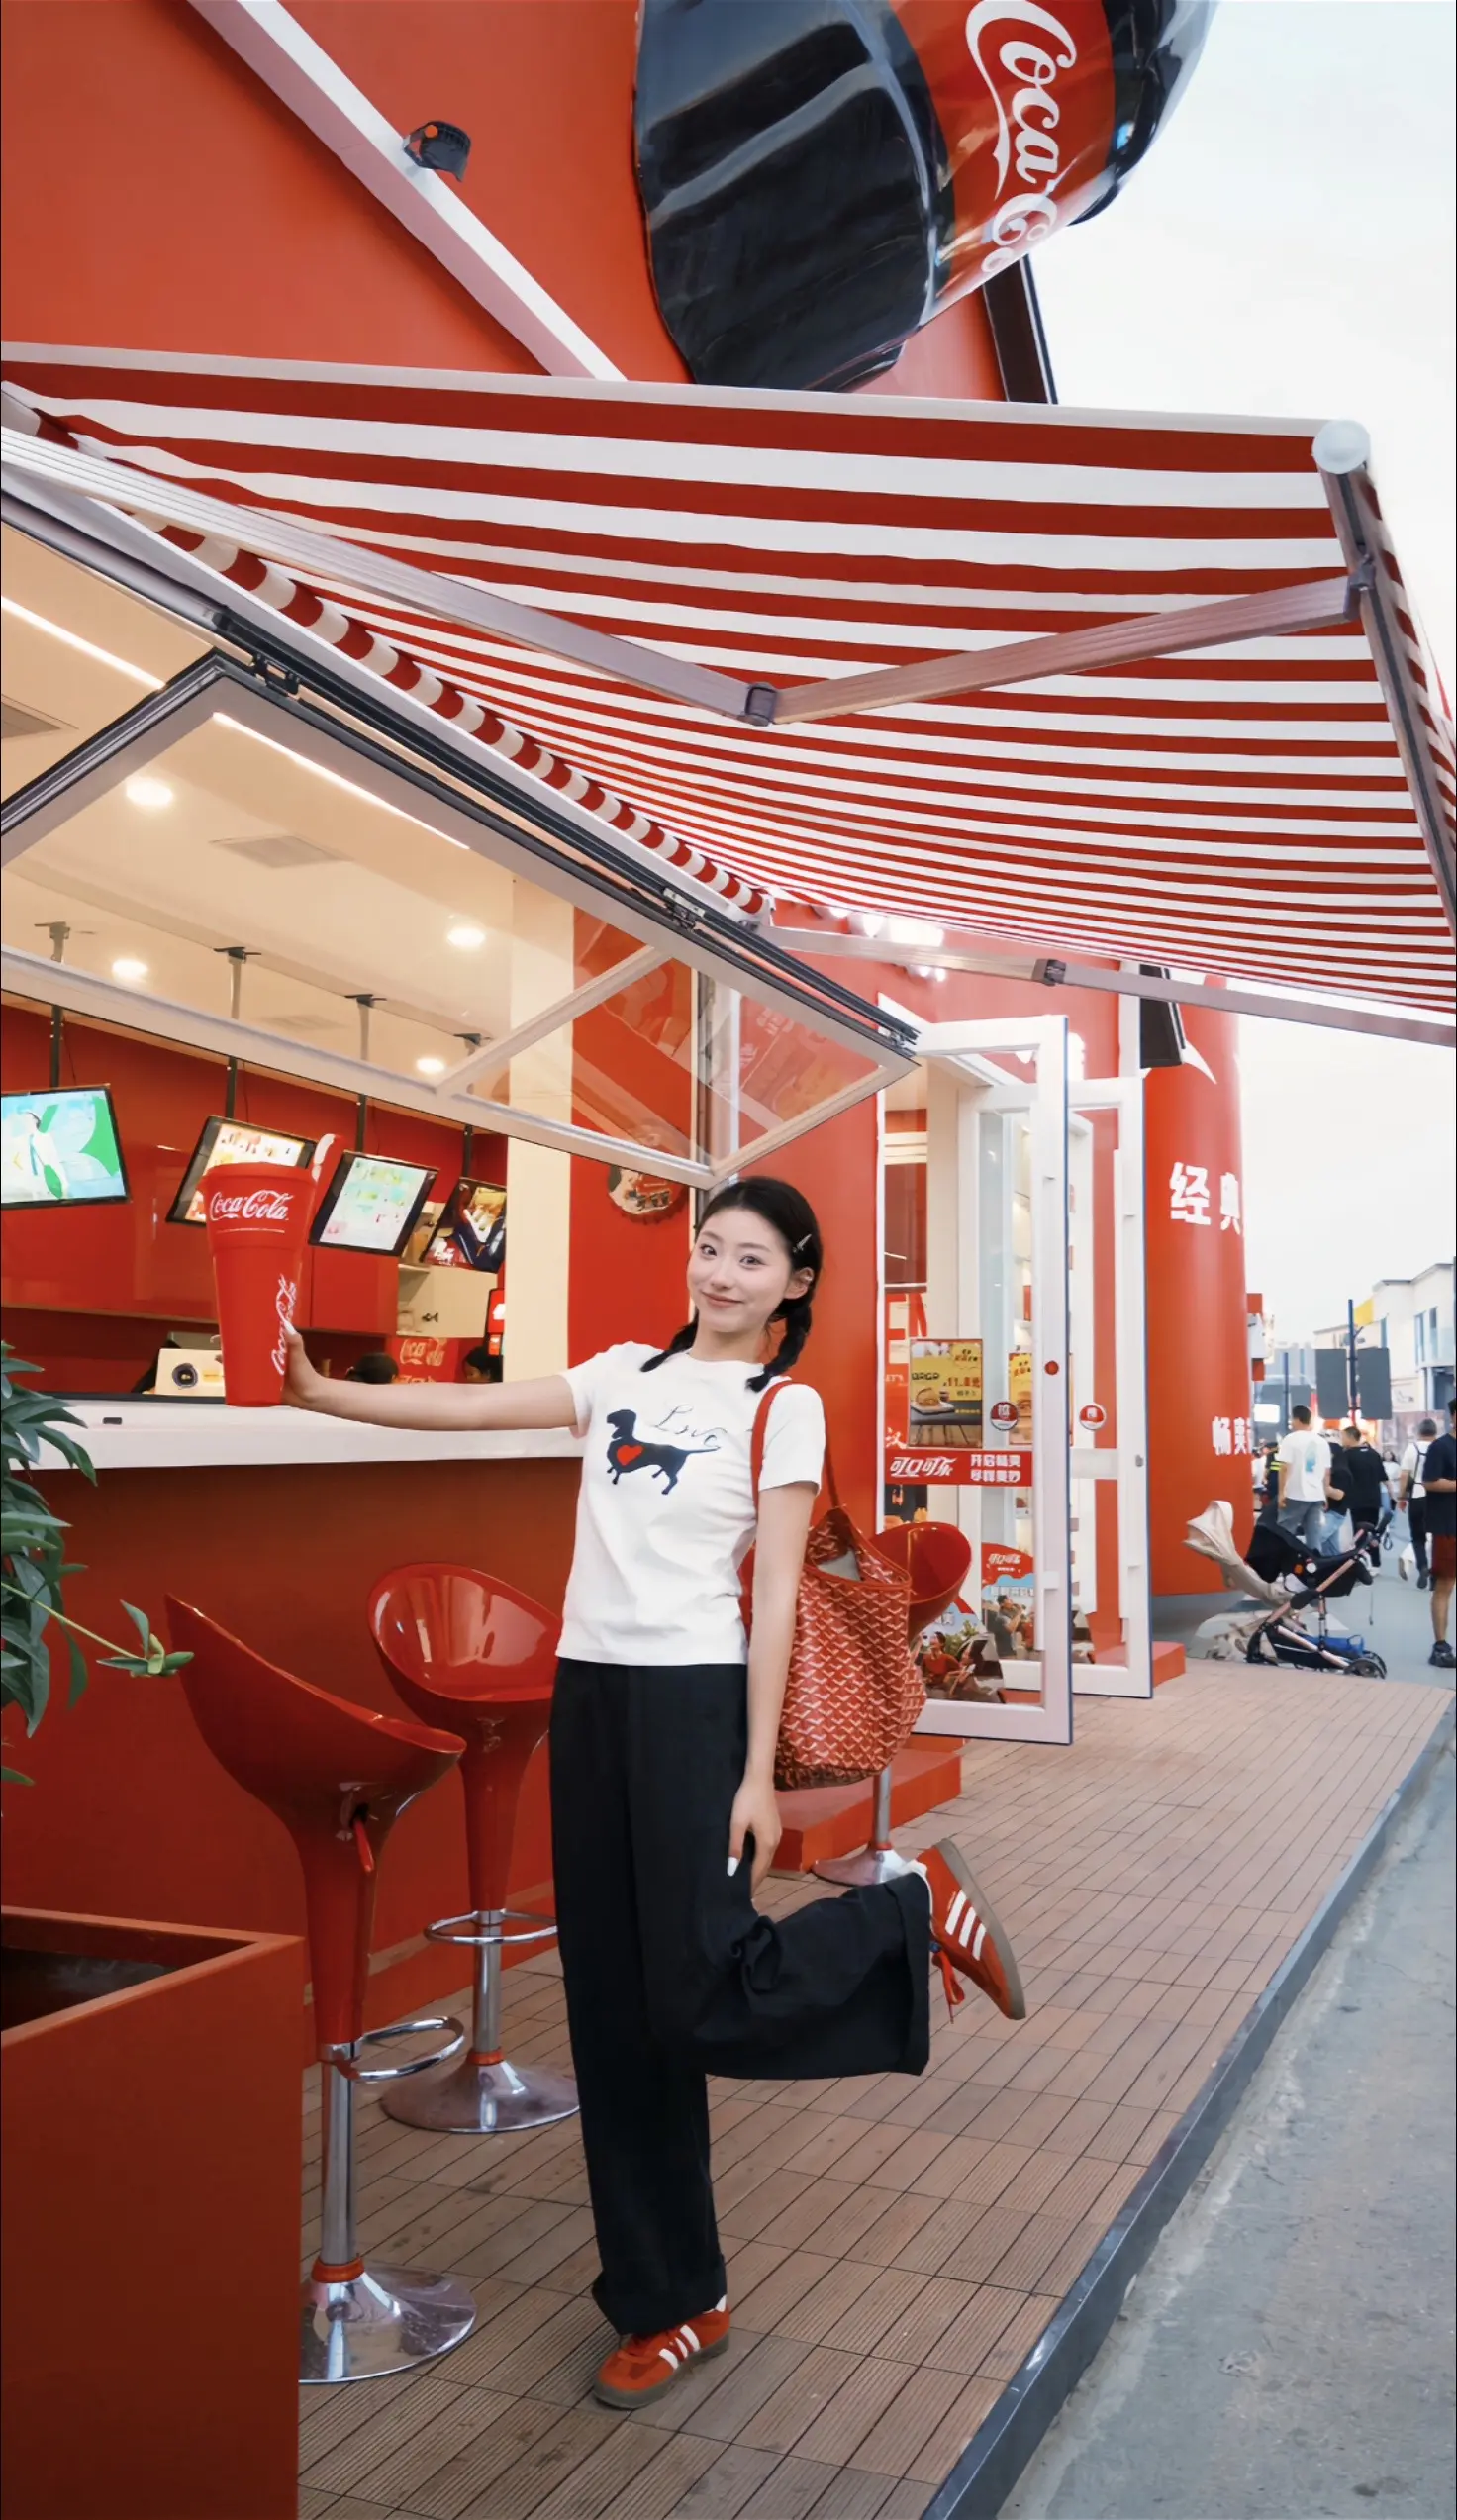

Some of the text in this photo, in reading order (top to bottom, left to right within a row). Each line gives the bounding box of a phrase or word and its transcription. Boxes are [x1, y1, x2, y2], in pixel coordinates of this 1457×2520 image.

[210, 1190, 294, 1221] Coca-Cola
[1170, 1162, 1241, 1235] 经典
[889, 1455, 957, 1478] 可口可乐
